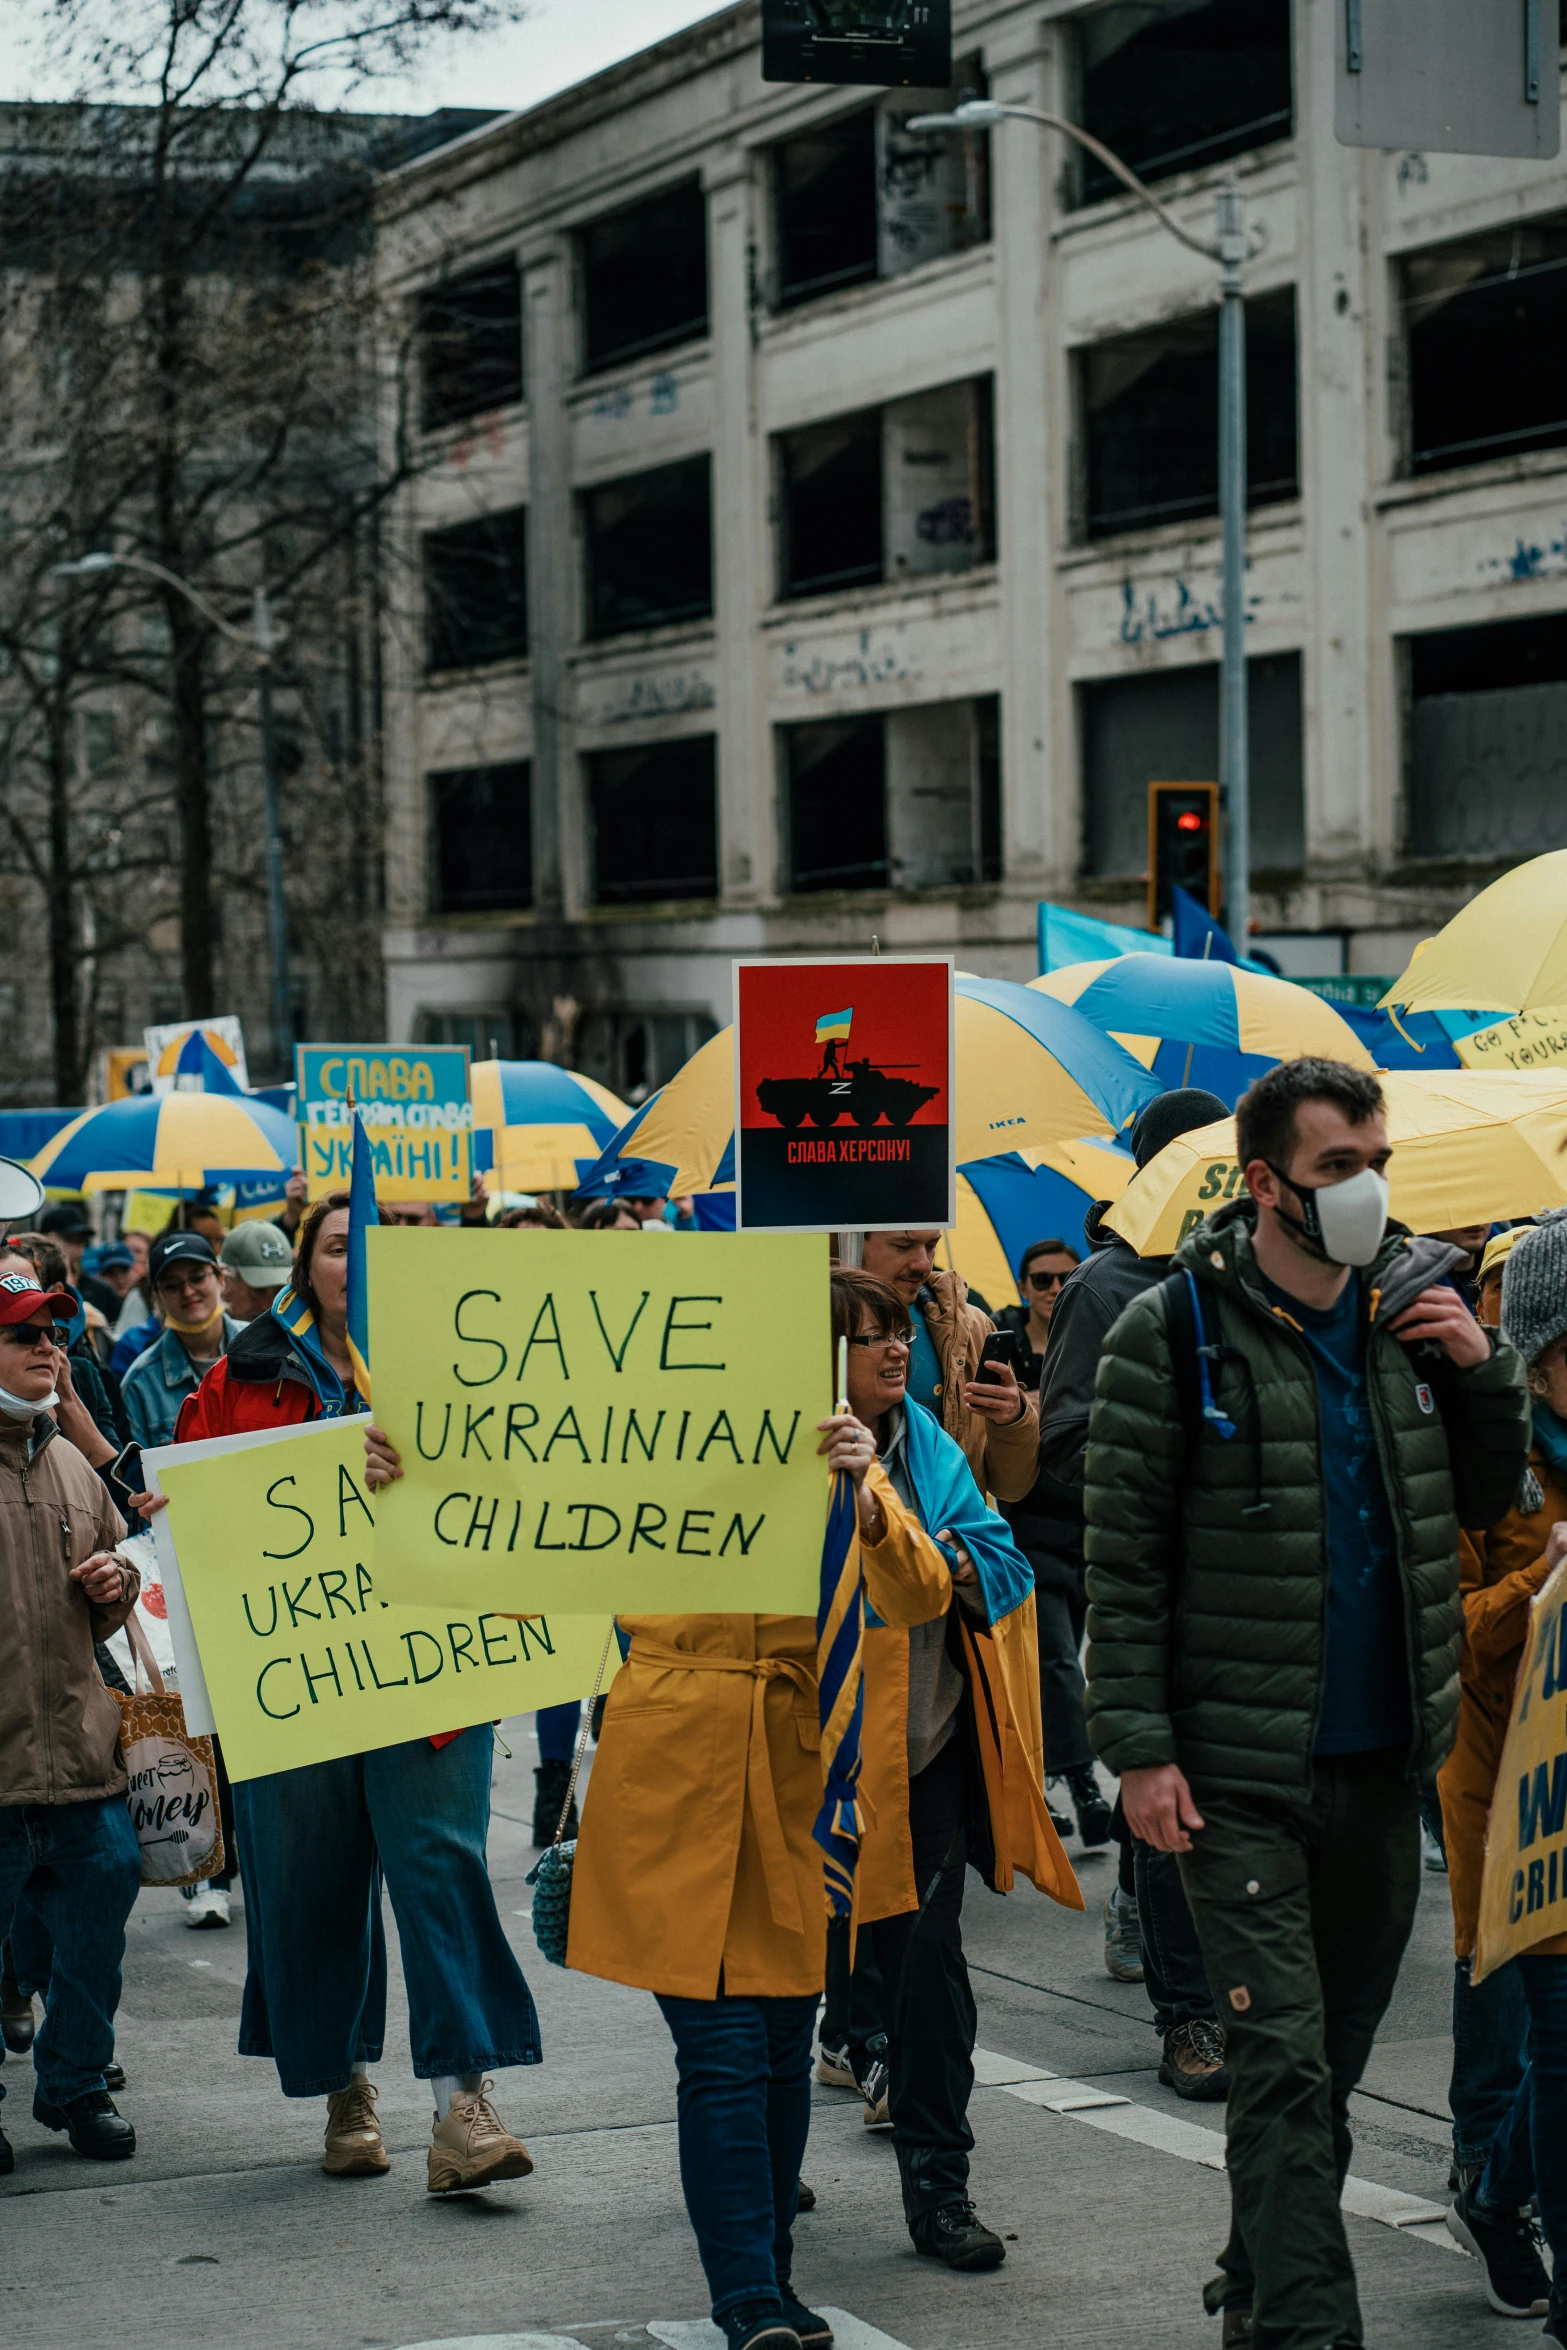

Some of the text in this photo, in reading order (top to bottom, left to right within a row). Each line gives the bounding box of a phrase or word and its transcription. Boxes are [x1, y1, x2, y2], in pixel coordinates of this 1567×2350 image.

[787, 1139, 910, 1164] СЛАВА ХЕРСОНУ!
[989, 1117, 1026, 1130] IKEA
[313, 1134, 459, 1181] УКАЇНІ!
[453, 1289, 727, 1387] SAVE
[415, 1401, 802, 1464] UKRAINIAN
[434, 1492, 766, 1556] CHILDREN
[256, 1613, 555, 1720] CHILDREN
